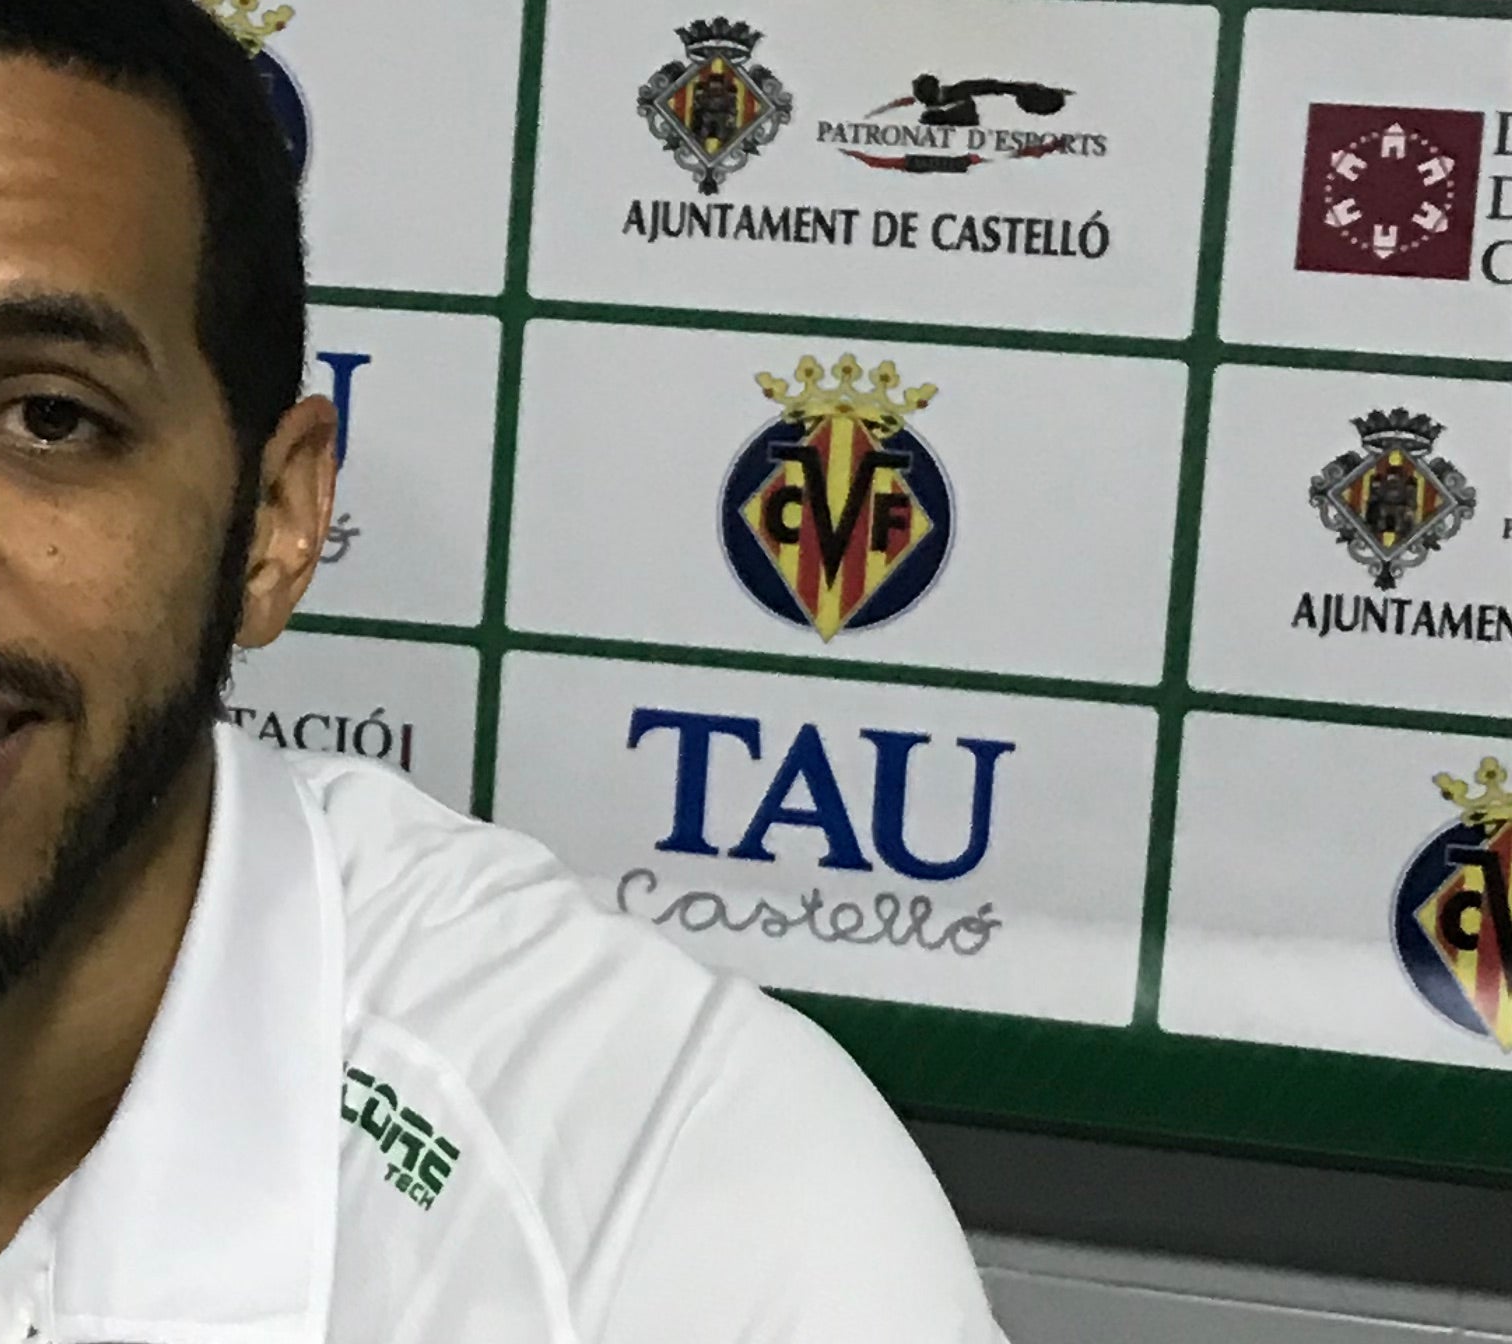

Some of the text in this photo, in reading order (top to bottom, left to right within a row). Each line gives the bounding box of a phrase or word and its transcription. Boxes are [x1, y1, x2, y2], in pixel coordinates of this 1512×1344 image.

[816, 119, 955, 147] PATRONAT
[623, 200, 1109, 259] AJUNTAMENT DE CASTELLÓ
[626, 706, 1016, 882] TAU
[384, 1163, 435, 1211] TECH
